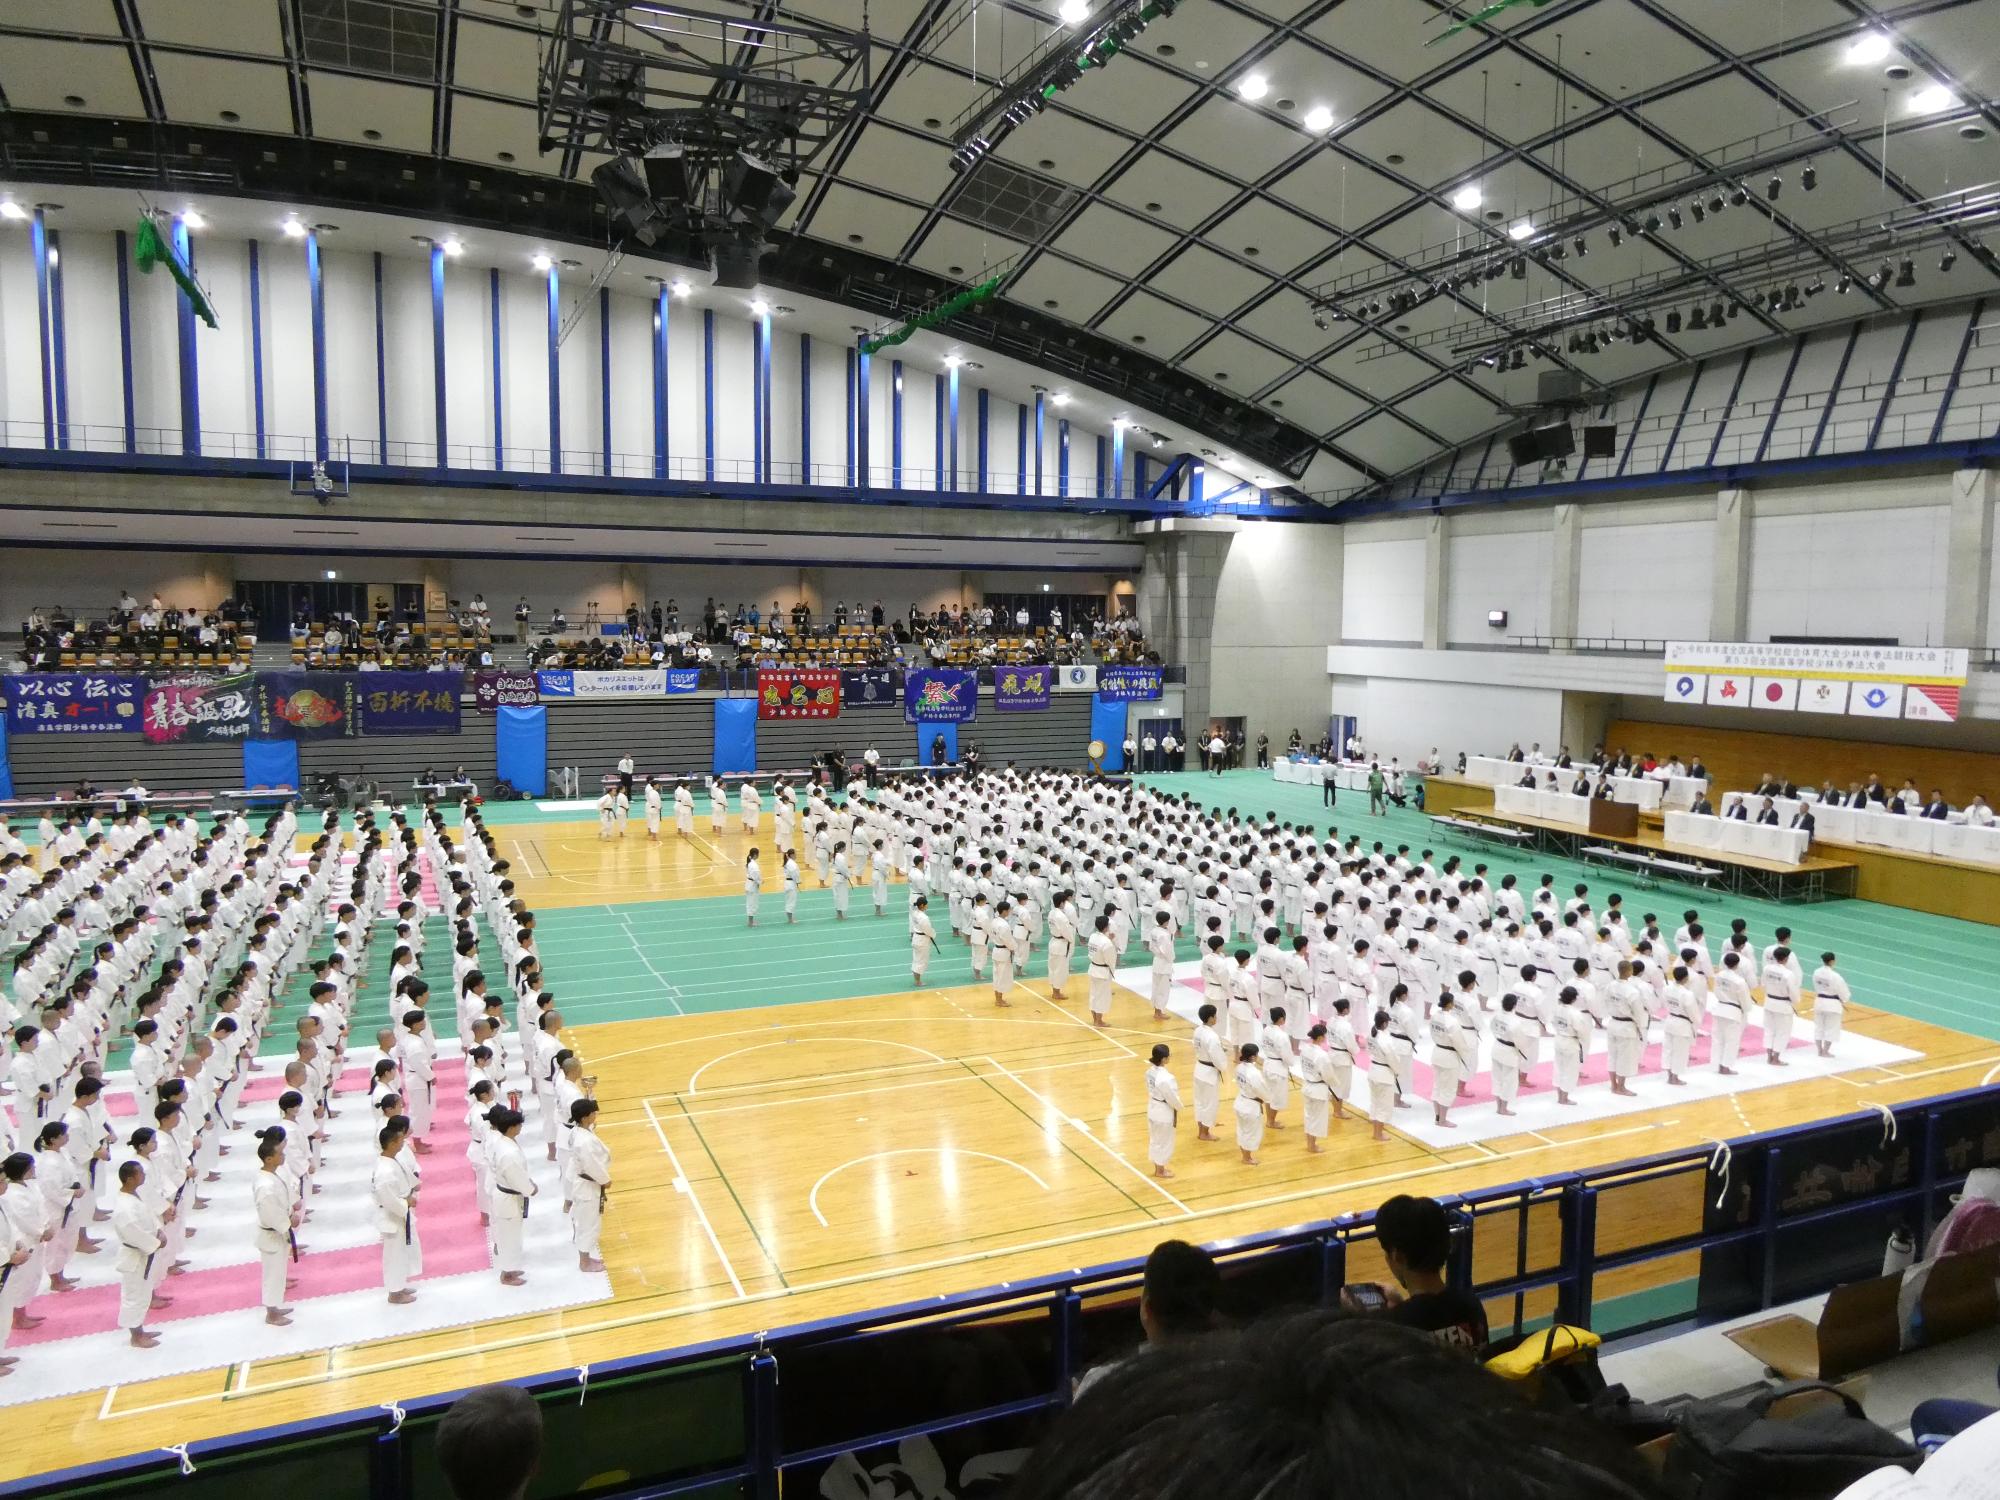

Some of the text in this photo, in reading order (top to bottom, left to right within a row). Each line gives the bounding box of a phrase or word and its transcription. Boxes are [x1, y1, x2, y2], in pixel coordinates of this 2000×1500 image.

[18, 680, 73, 697] 以心
[83, 678, 133, 698] 伝心
[578, 683, 662, 692] インターハイを応援しています
[597, 675, 644, 683] ポカリスエットは
[1001, 672, 1044, 695] 飛翔
[922, 681, 961, 704] 繋ぐ
